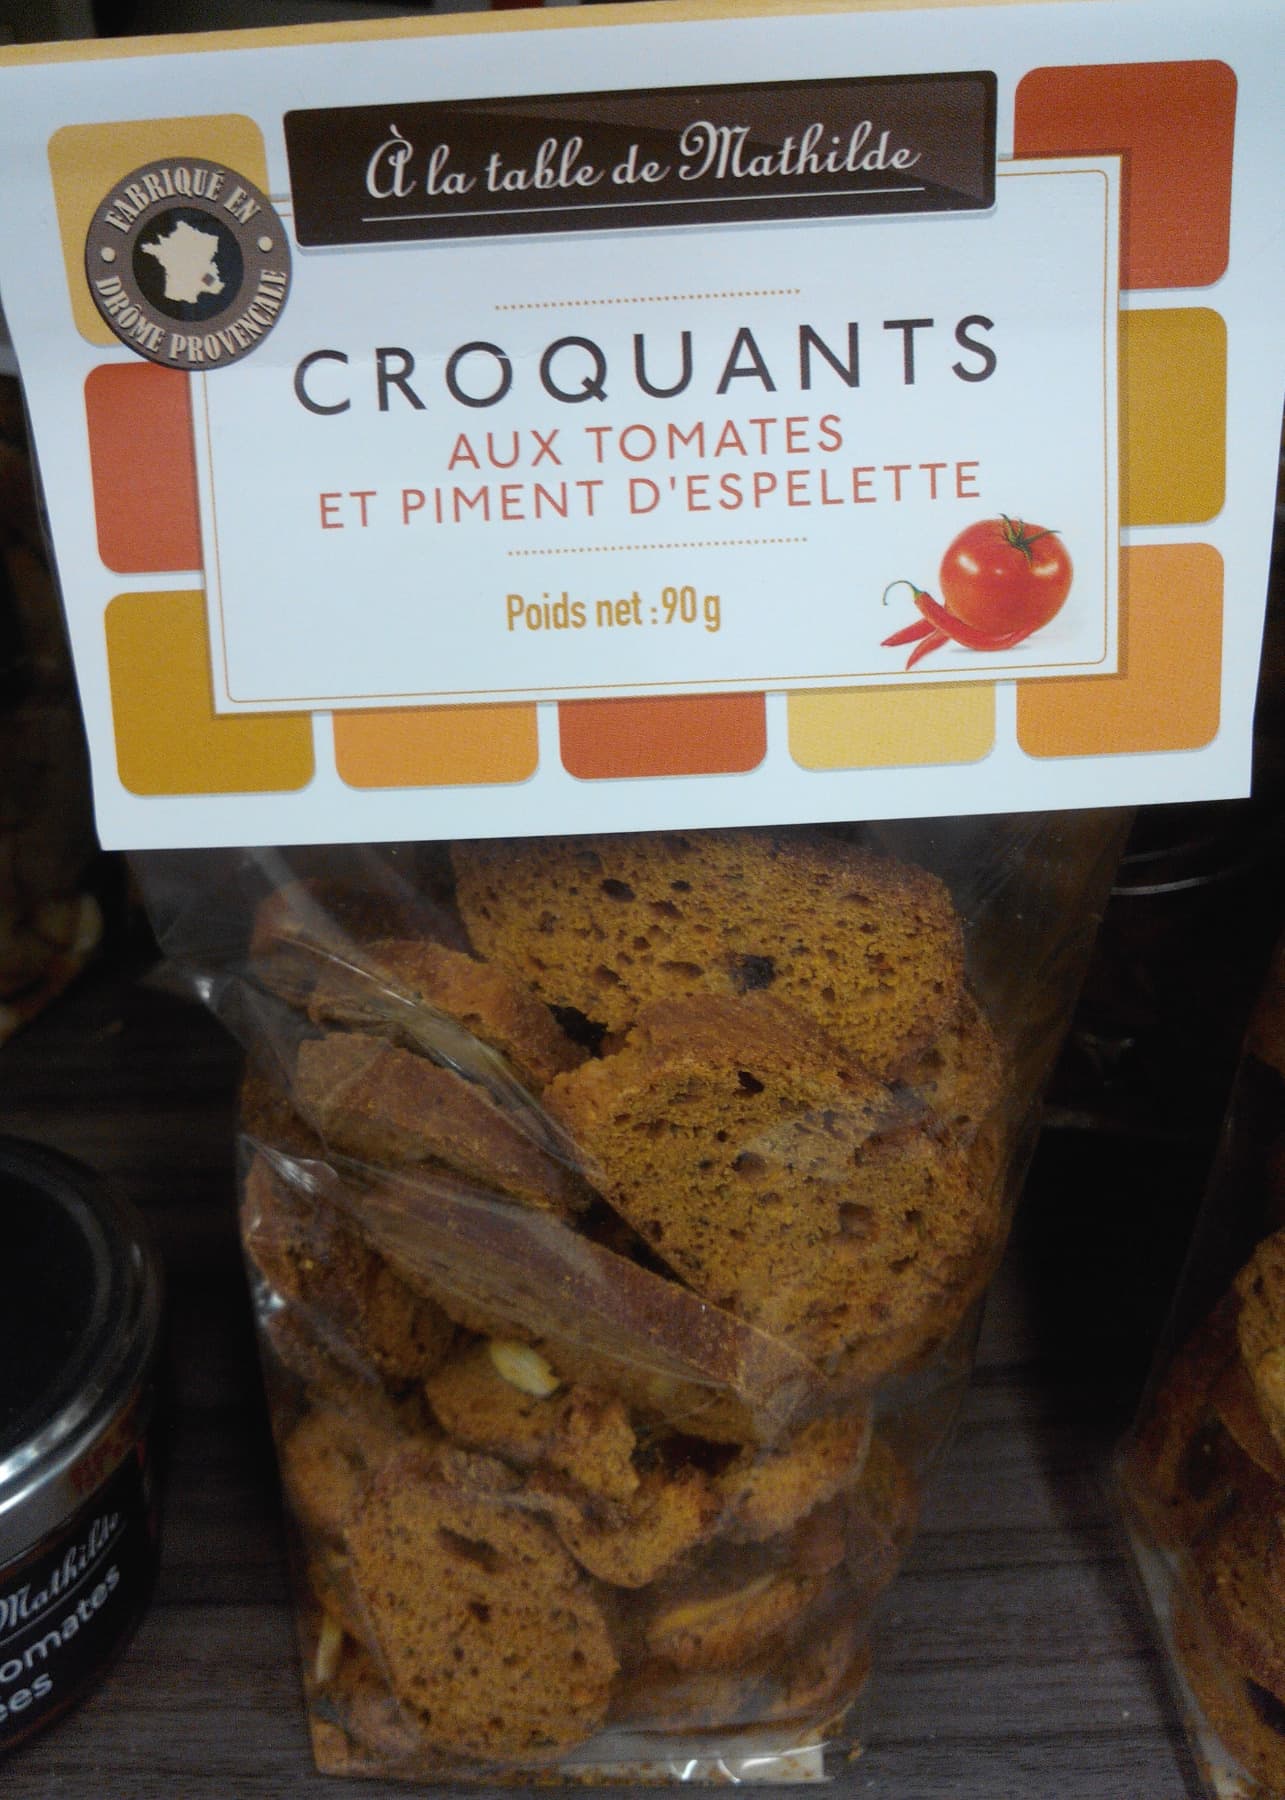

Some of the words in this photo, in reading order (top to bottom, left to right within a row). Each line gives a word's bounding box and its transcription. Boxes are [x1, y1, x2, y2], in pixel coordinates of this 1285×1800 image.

[365, 123, 417, 198] À
[426, 144, 476, 195] la
[485, 135, 607, 192] table
[611, 144, 672, 185] de
[679, 120, 922, 180] Mathilde
[104, 167, 225, 234] FABRIQUÉ
[223, 186, 262, 225] EN
[95, 275, 166, 353] DRÔME
[294, 314, 997, 416] CROQUANTS
[448, 428, 562, 470] AUX
[584, 414, 843, 463] TOMATES
[319, 491, 377, 529] ET
[402, 480, 604, 525] PIMENT
[628, 461, 981, 514] D'ESPELETTE
[506, 592, 587, 632] Poids
